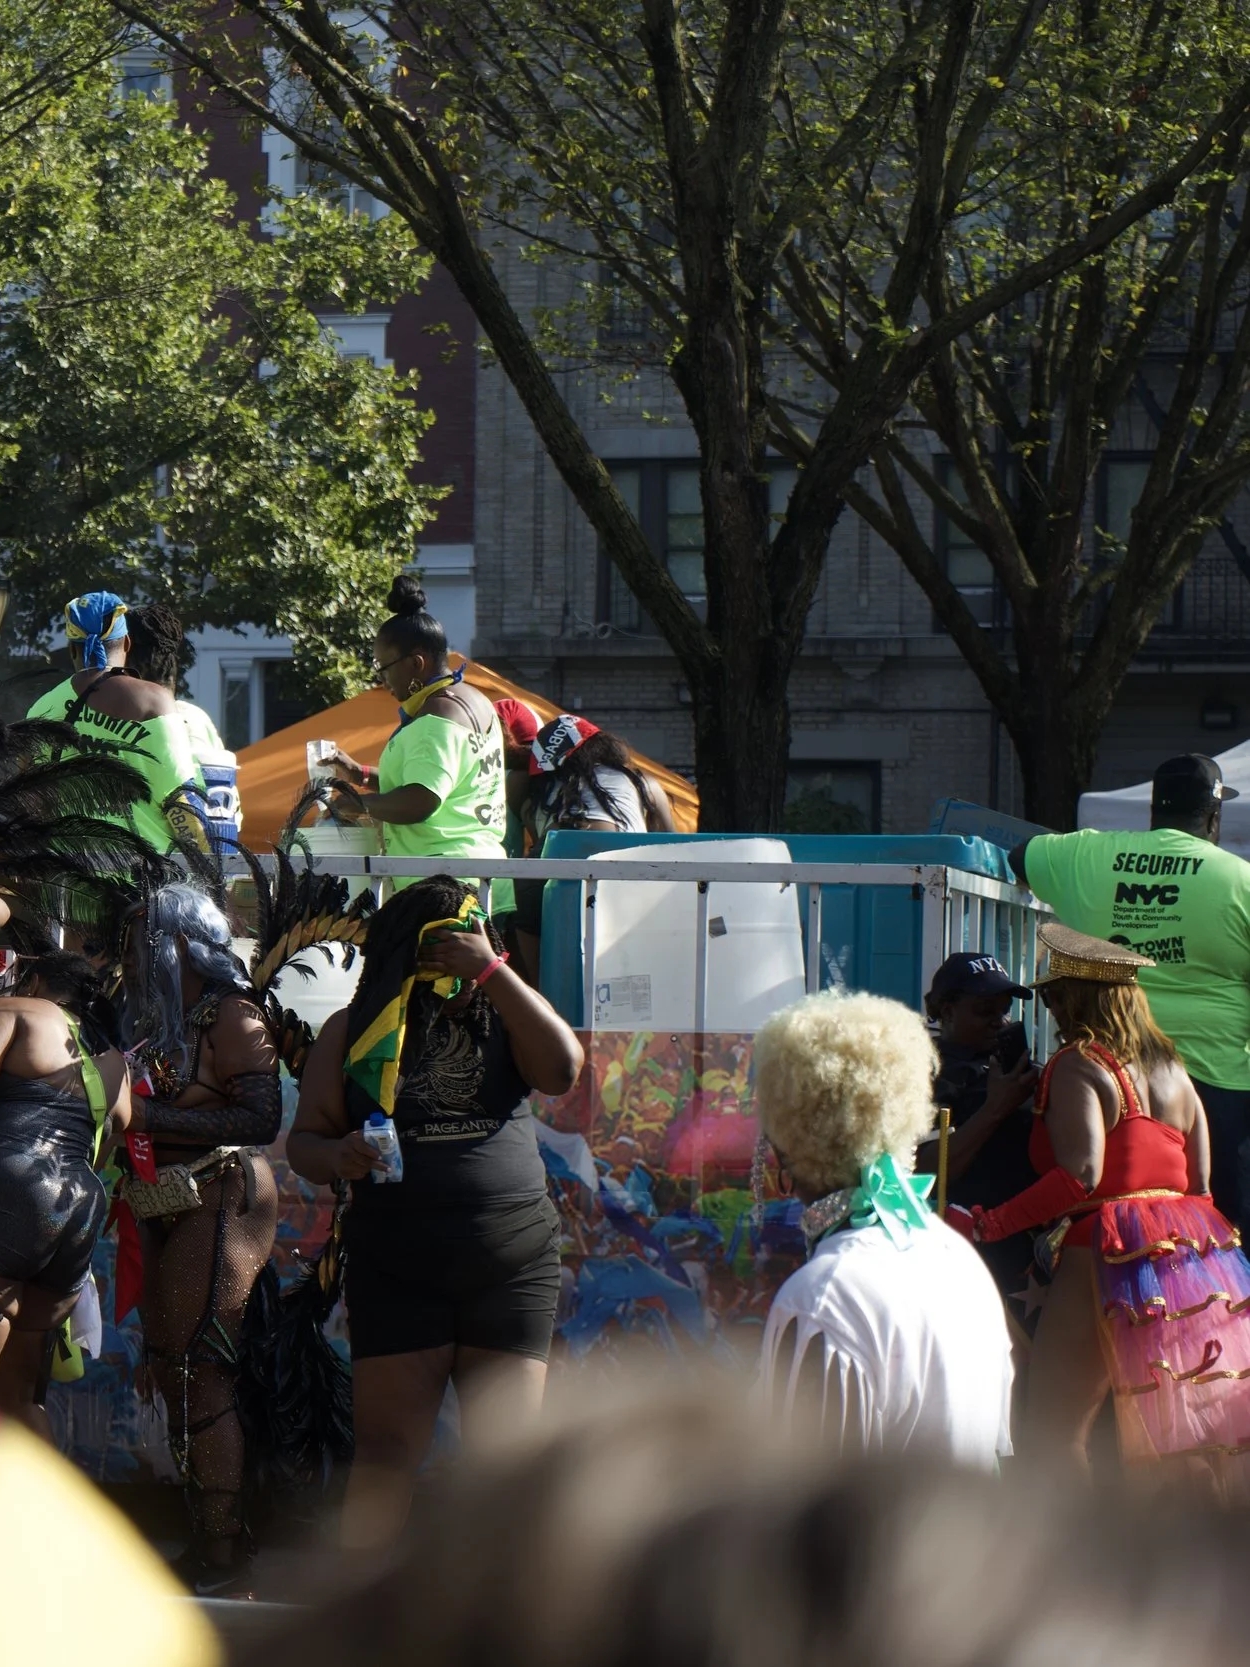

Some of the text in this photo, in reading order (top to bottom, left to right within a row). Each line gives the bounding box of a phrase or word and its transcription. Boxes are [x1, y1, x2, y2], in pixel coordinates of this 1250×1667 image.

[1112, 852, 1205, 876] SECURITY
[1114, 881, 1181, 906] NYC
[1113, 905, 1156, 914] Department
[1113, 913, 1133, 921] Youth
[1141, 914, 1182, 922] Community
[1111, 921, 1159, 930] Development
[424, 1119, 501, 1136] PAGEANTRY
